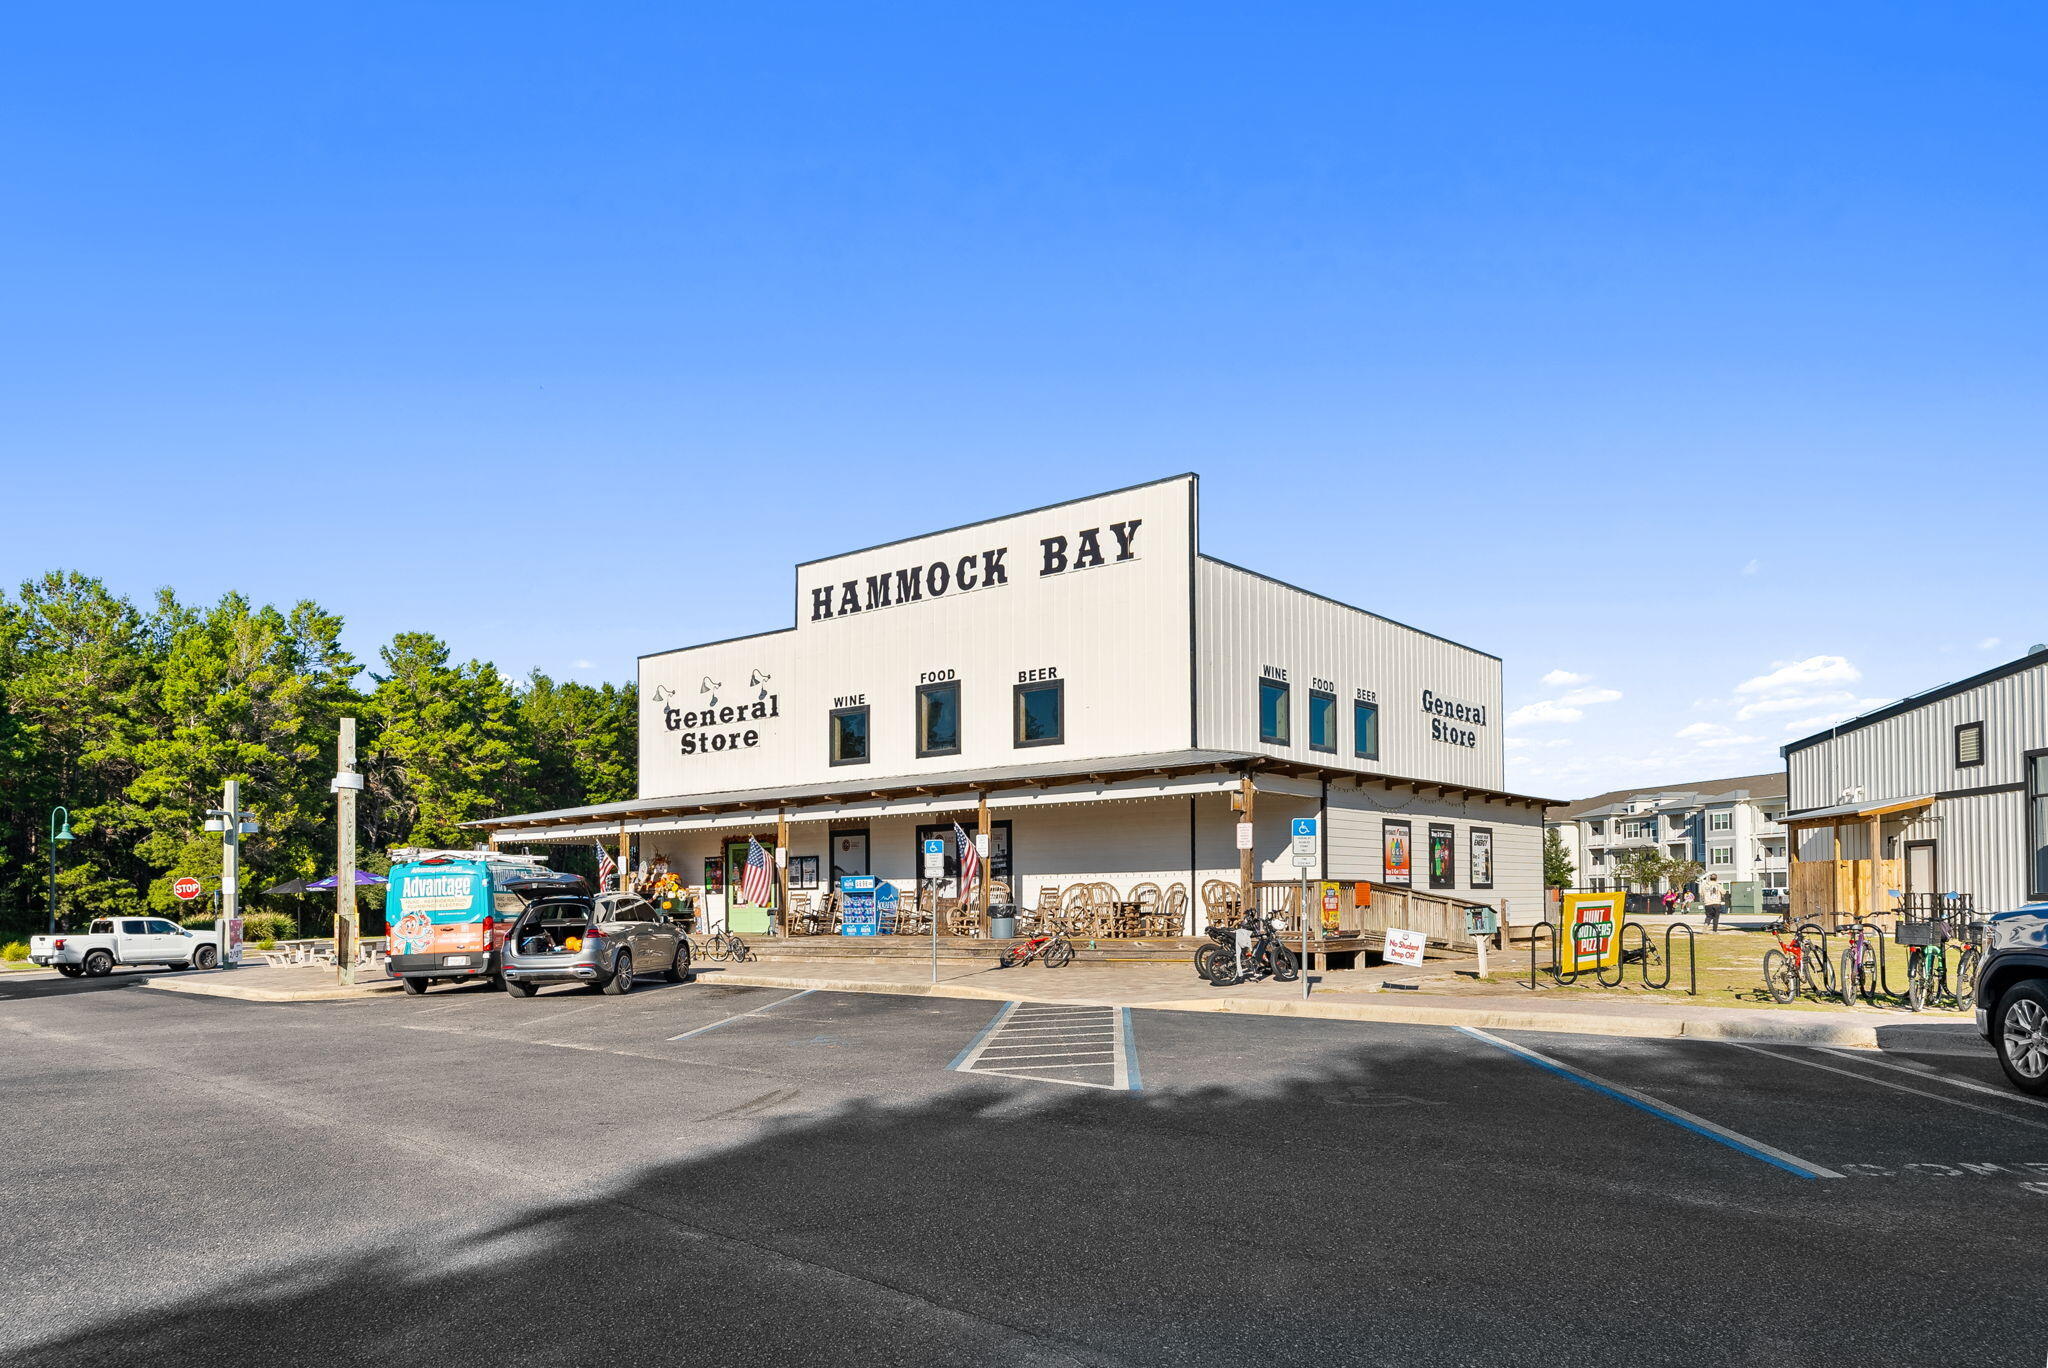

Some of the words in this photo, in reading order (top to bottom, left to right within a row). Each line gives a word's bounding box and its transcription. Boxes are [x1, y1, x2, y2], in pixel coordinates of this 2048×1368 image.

[811, 547, 1008, 622] HAMMOCK
[1039, 519, 1142, 577] BAY
[920, 668, 955, 684] FOOD
[1018, 667, 1058, 683] BEER
[1263, 664, 1287, 681] WINE
[1312, 677, 1335, 692] FOOD
[833, 694, 866, 708] WINE
[1356, 688, 1377, 702] BEER
[665, 694, 779, 731] General
[1422, 689, 1486, 727] General
[1431, 717, 1476, 748] Store
[681, 729, 759, 755] Store
[176, 883, 199, 894] STOP
[402, 875, 471, 898] Advantage
[1583, 909, 1605, 923] HUNT
[1389, 939, 1398, 947] No
[1398, 940, 1420, 951] Student
[1391, 948, 1405, 959] Drop
[1405, 951, 1416, 960] Off
